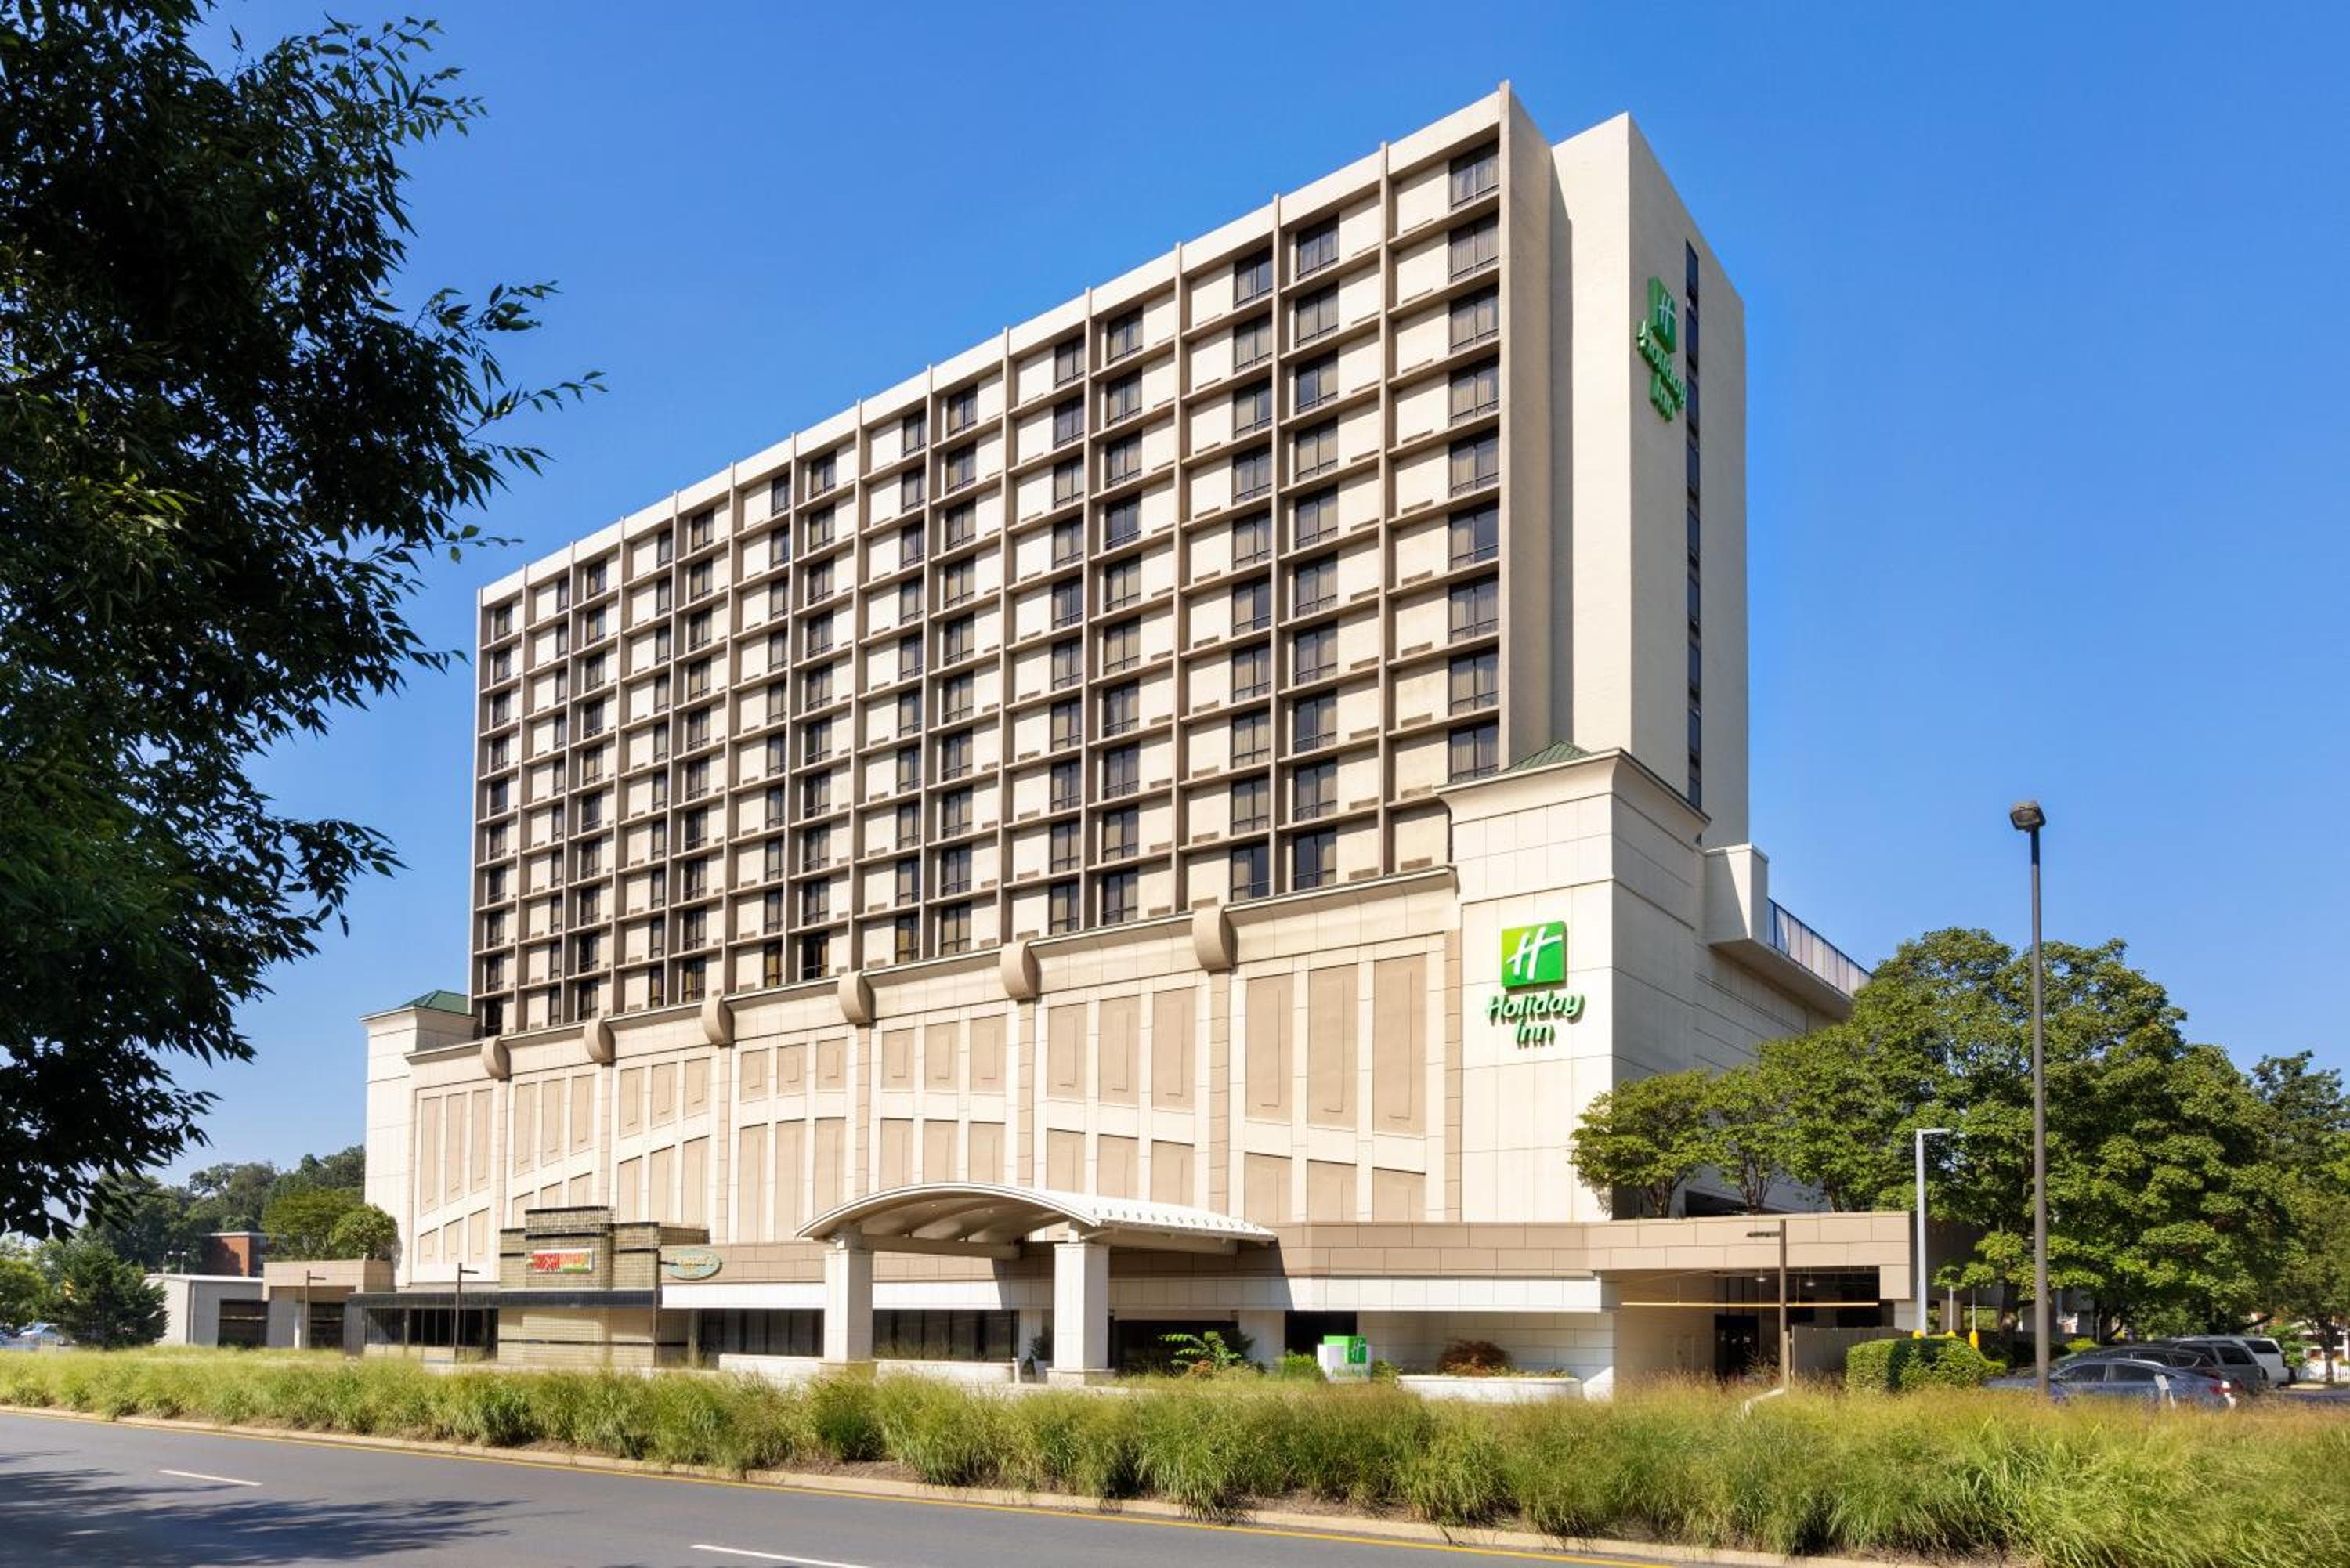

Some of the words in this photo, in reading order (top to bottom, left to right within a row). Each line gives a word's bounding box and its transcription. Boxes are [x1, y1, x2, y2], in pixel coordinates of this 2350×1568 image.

[1636, 320, 1687, 412] Holiday
[1650, 374, 1675, 421] Inn
[1506, 926, 1564, 980] H
[1485, 990, 1585, 1024] Holiday
[1515, 1018, 1555, 1048] Inn
